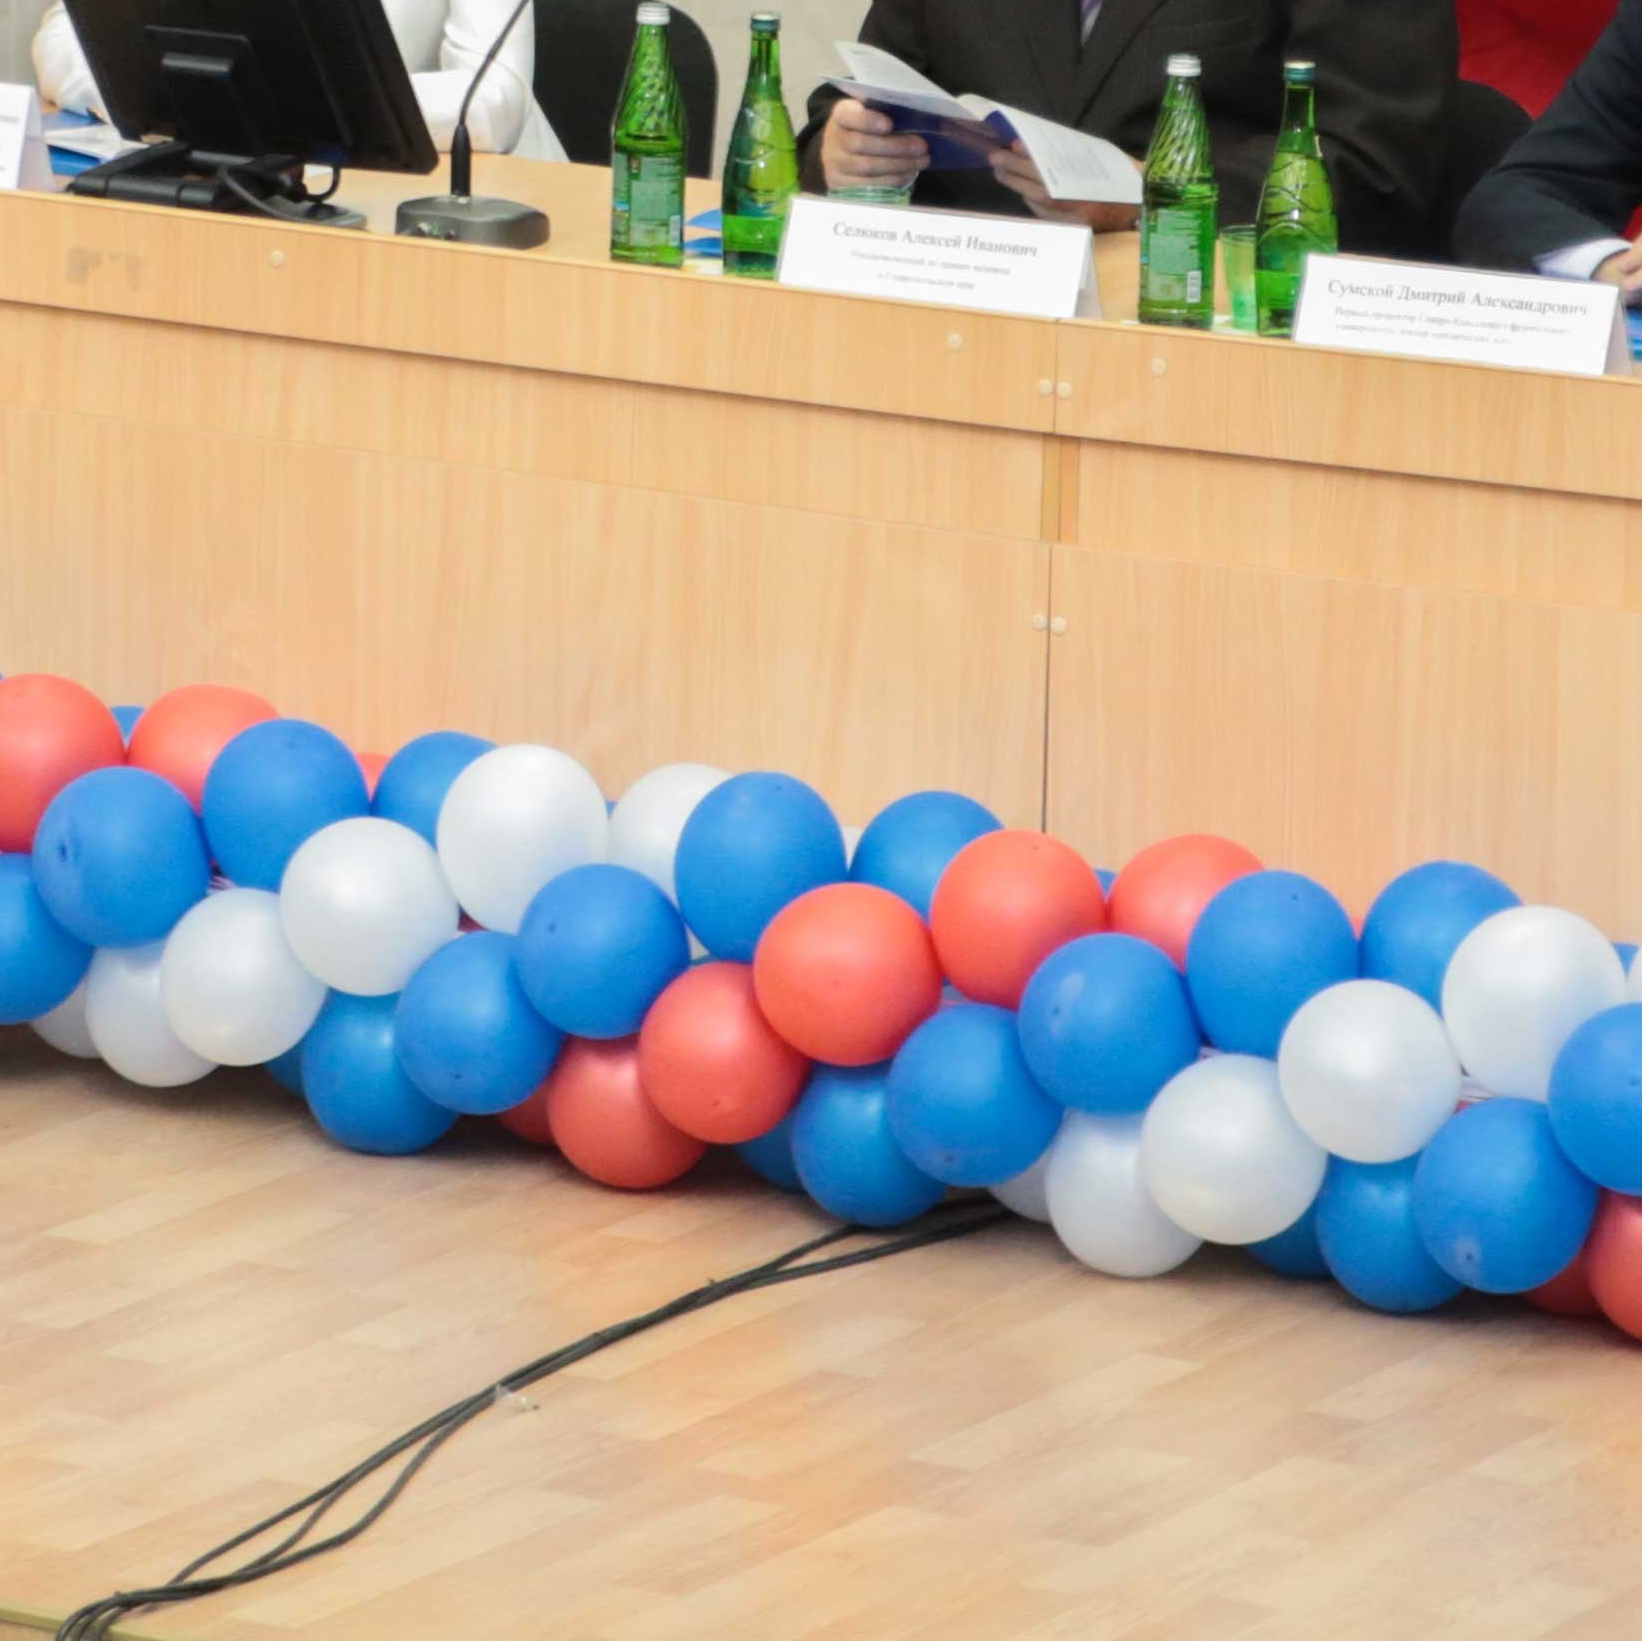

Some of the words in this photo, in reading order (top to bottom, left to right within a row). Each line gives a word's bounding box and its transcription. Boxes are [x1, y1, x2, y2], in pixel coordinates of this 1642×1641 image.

[832, 221, 897, 242] Селюков
[901, 229, 963, 249] Алексей
[965, 236, 1038, 257] Иванович
[1328, 278, 1393, 301] Сумской
[1397, 286, 1465, 307] Дмитрий
[1470, 293, 1588, 316] Александрович
